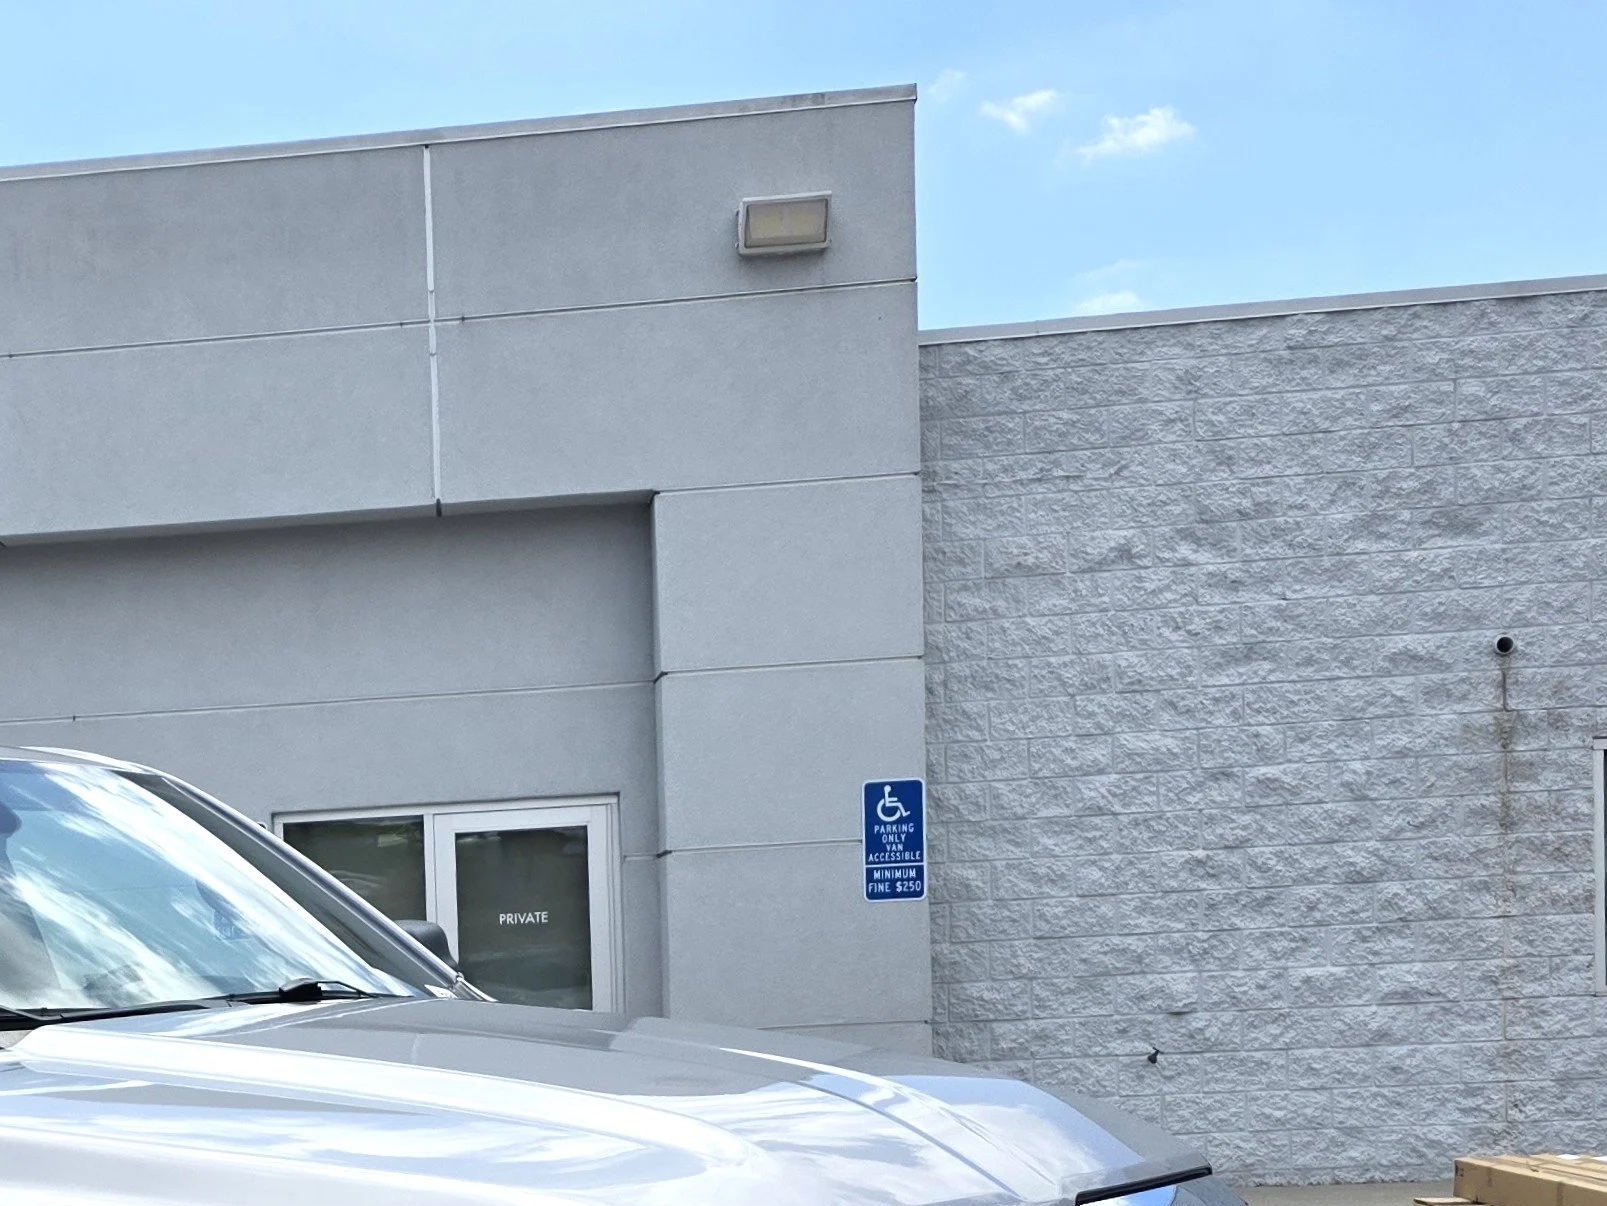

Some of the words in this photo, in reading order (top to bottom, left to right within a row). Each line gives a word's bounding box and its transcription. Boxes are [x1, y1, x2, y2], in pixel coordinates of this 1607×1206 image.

[874, 823, 914, 834] PARKING
[882, 833, 906, 843] ONLY
[886, 843, 903, 851] VAN
[868, 851, 921, 862] ACCESSIBLE
[873, 868, 916, 879] MINIMUM
[868, 882, 891, 893] FINE
[896, 881, 921, 892] $250
[499, 911, 548, 925] PRIVATE
